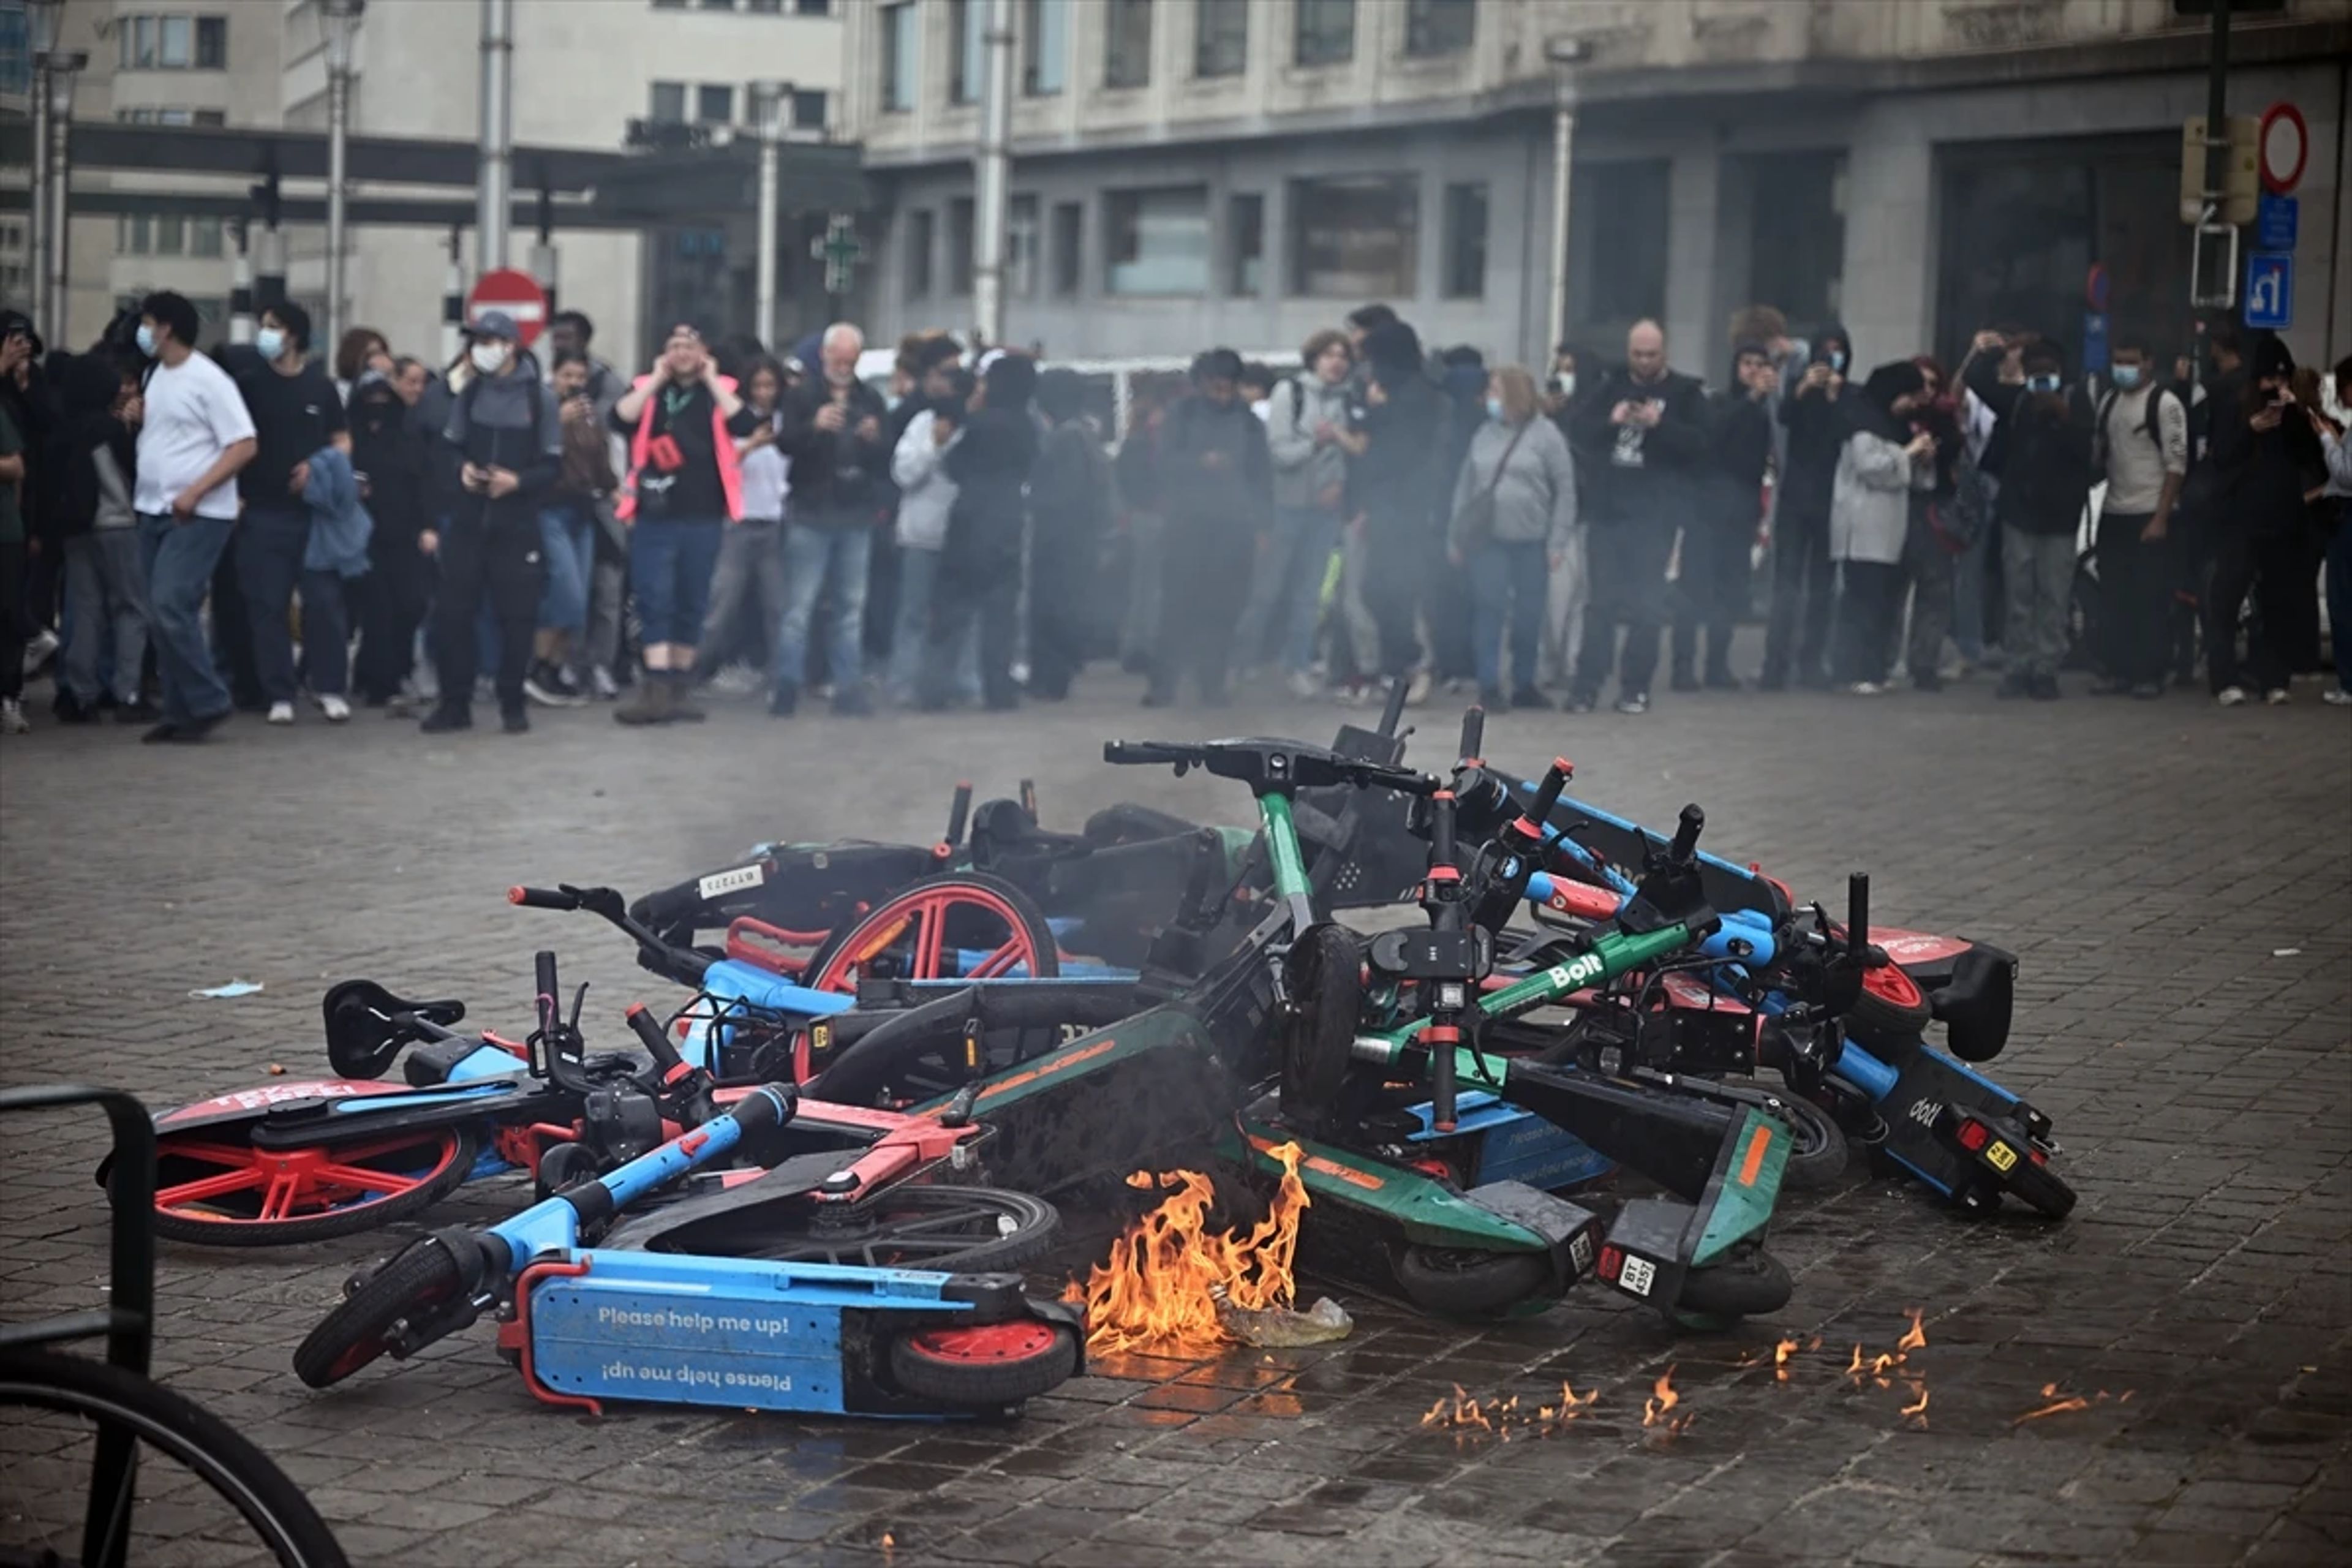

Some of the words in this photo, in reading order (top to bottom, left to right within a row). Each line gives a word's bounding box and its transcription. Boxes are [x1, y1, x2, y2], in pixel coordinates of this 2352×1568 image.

[1547, 953, 1604, 989] Bolt
[1625, 1262, 1637, 1283] BT
[598, 1307, 666, 1326] Please
[669, 1311, 714, 1333] help
[718, 1317, 751, 1332] me
[755, 1317, 790, 1338] up!
[601, 1360, 635, 1381] up!
[638, 1366, 672, 1382] me
[676, 1364, 721, 1388] help
[725, 1371, 792, 1392] Please
